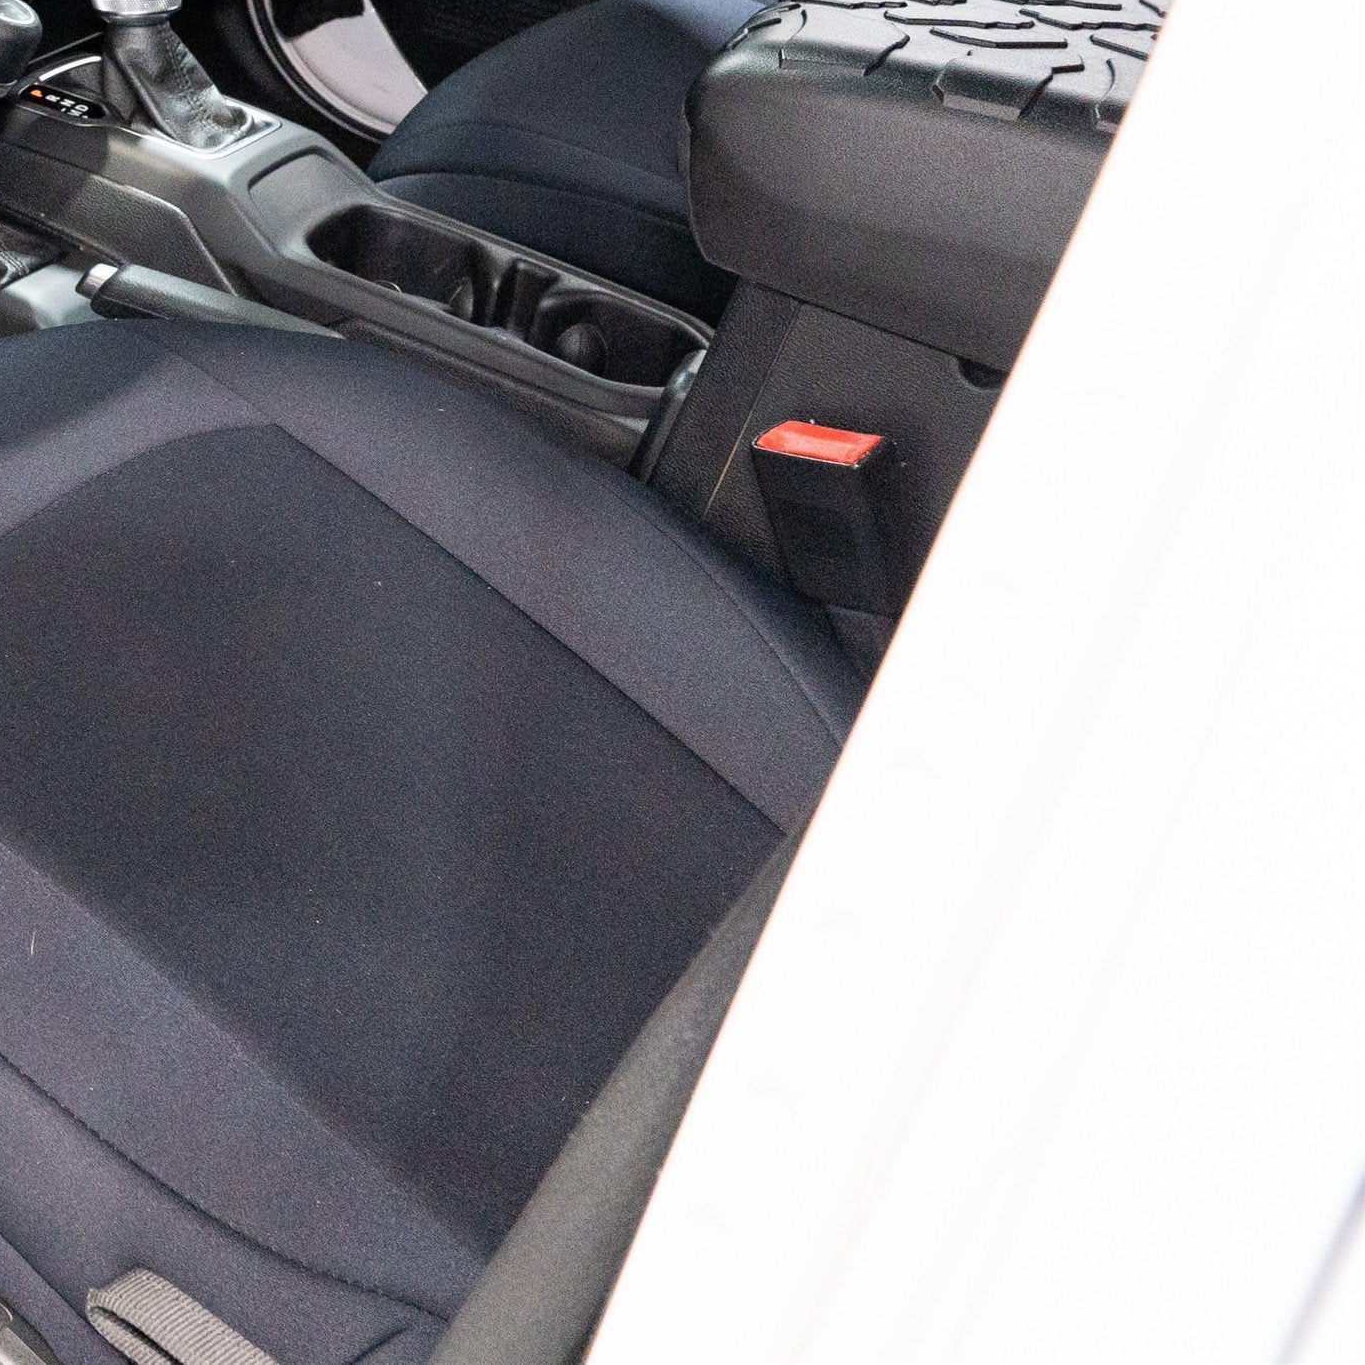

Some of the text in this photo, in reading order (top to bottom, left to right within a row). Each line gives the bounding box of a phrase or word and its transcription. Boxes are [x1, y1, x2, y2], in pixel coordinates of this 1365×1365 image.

[44, 94, 61, 103] R
[59, 98, 76, 108] N
[74, 104, 89, 113] D
